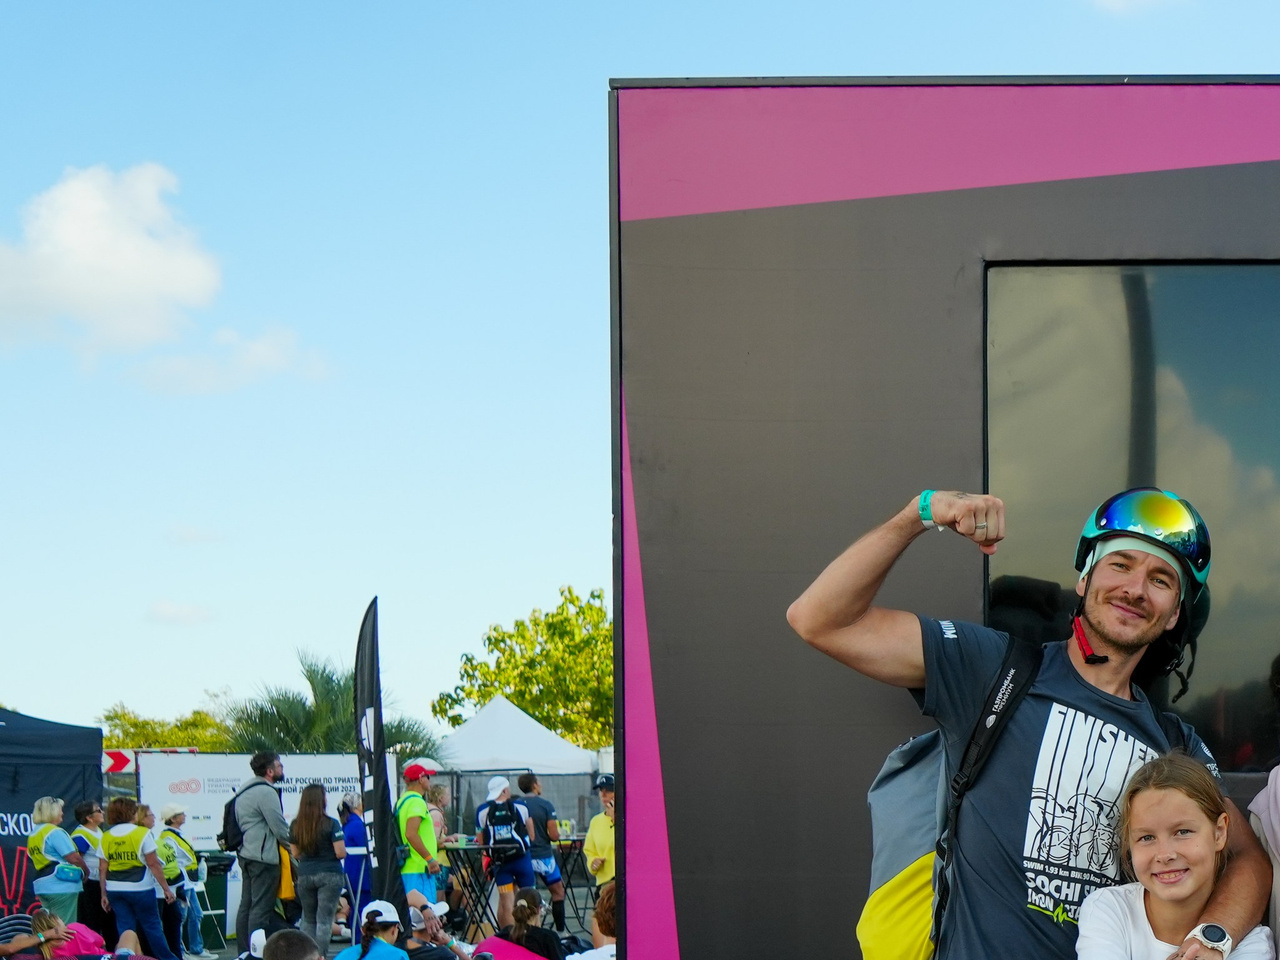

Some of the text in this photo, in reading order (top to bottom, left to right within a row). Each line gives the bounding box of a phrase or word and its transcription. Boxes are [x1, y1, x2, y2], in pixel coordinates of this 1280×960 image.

[341, 785, 356, 793] 2023
[1023, 860, 1044, 871] SWIM
[1044, 865, 1059, 876] 1.93
[1059, 868, 1069, 877] km
[1025, 872, 1081, 902] SOCHI
